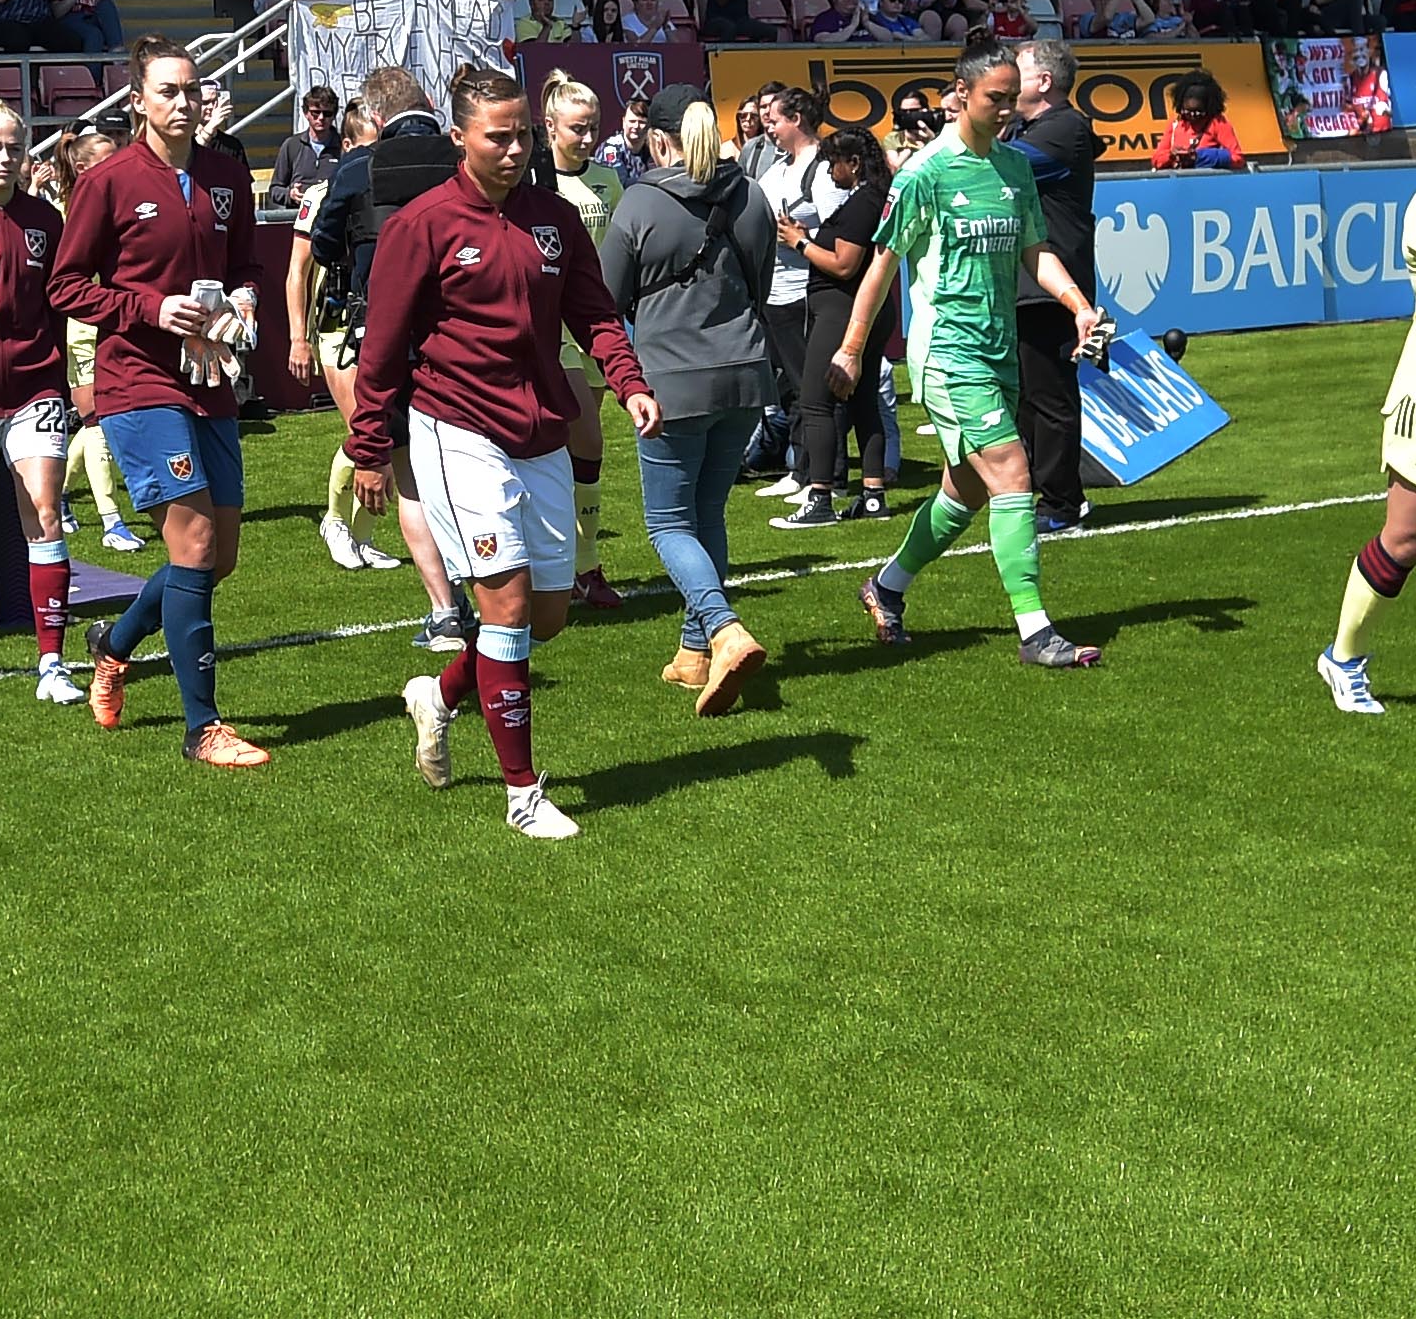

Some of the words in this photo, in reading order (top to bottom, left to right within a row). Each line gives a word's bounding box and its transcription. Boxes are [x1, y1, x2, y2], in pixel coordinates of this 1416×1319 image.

[315, 31, 352, 72] MY
[1312, 67, 1336, 83] GOT
[1191, 202, 1412, 294] BARCL
[35, 400, 66, 432] 22
